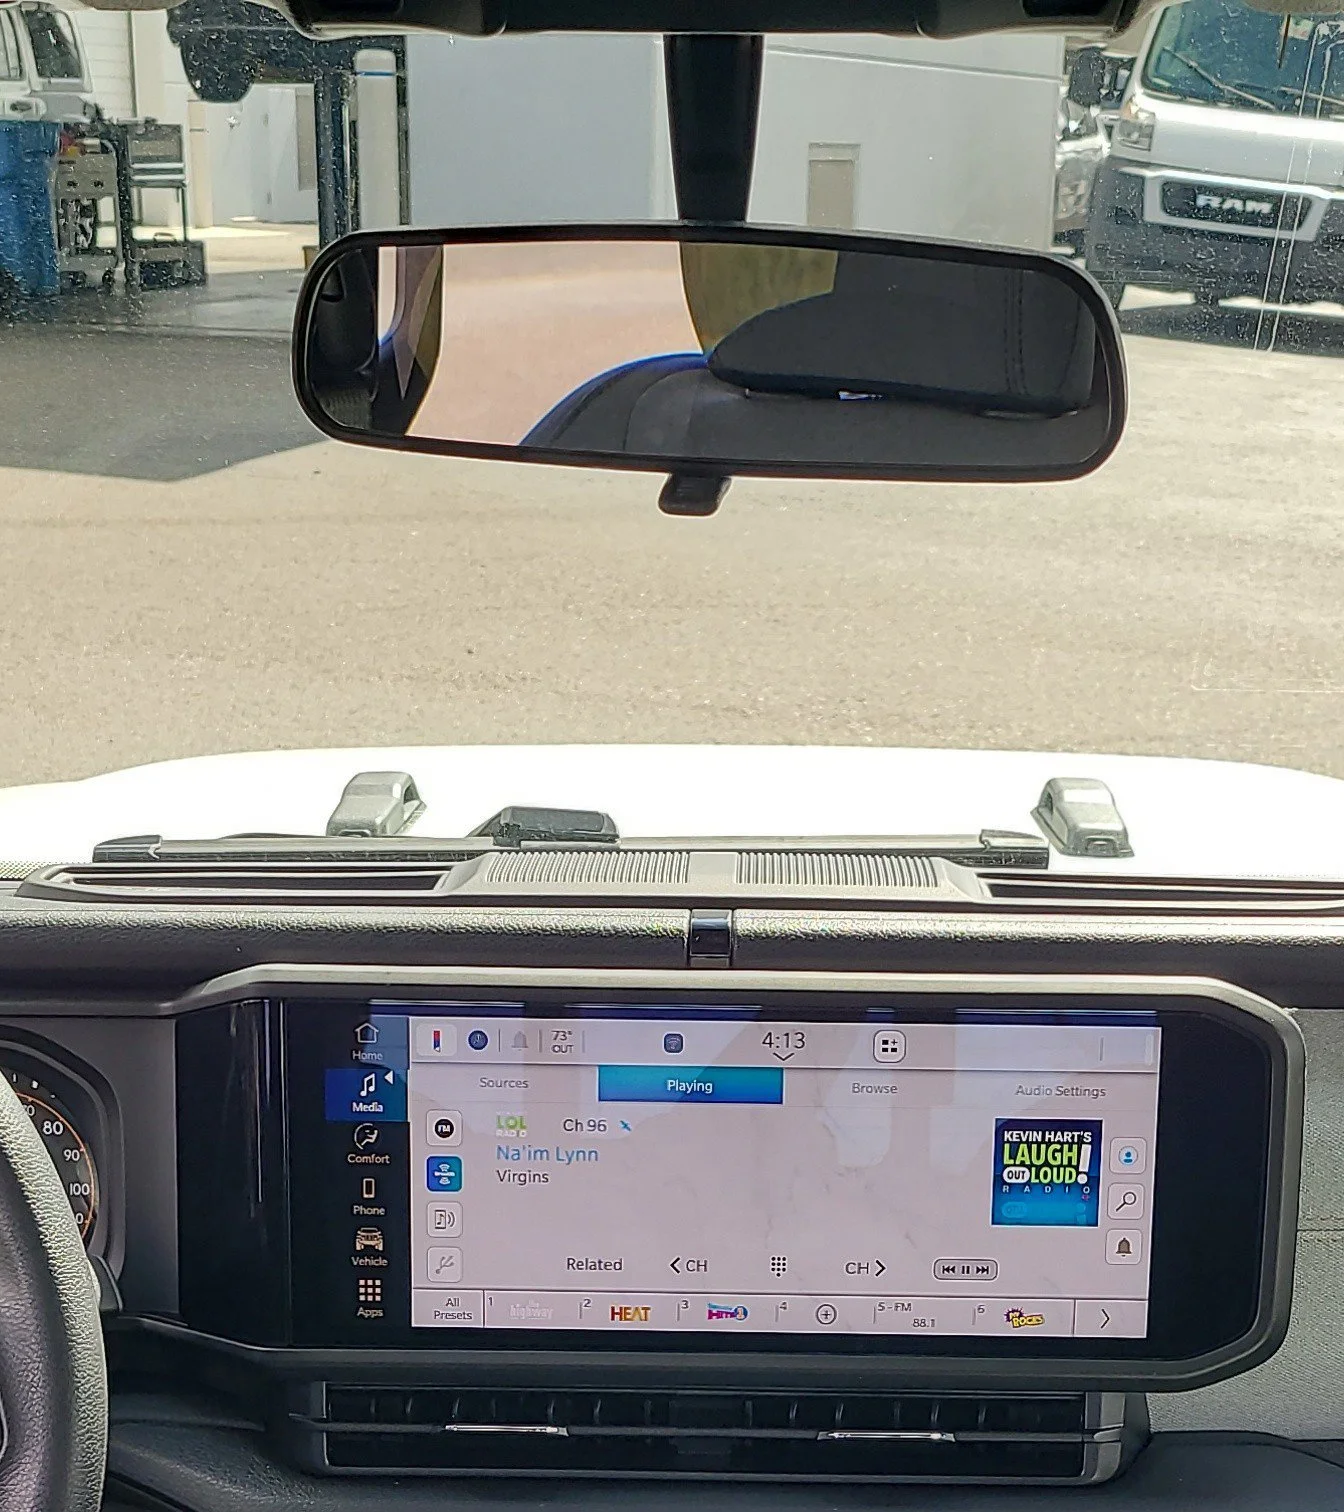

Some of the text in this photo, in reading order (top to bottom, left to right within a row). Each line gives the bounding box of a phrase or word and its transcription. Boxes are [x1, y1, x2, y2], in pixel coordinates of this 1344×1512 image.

[1195, 194, 1272, 214] RAM
[552, 1029, 573, 1041] 73°
[762, 1032, 806, 1050] 4:13
[552, 1043, 574, 1054] OUT
[352, 1050, 384, 1061] Home
[479, 1077, 529, 1089] Sources
[667, 1078, 713, 1093] Playing
[852, 1082, 898, 1094] Browse
[1015, 1084, 1106, 1100] Audio Settings
[352, 1101, 384, 1113] Media
[42, 1120, 64, 1135] 80
[497, 1115, 527, 1129] LOL
[563, 1119, 607, 1132] Ch 96
[1004, 1131, 1092, 1142] KEVIN HART'S
[63, 1149, 81, 1161] 90
[347, 1153, 390, 1164] Comfort
[497, 1145, 598, 1165] Na'im Lynn
[1003, 1144, 1078, 1165] LAUGH
[497, 1170, 549, 1185] Virgins
[1007, 1170, 1026, 1180] OUT
[69, 1182, 90, 1196] 100
[353, 1205, 386, 1216] Phone
[351, 1256, 388, 1267] Vehicle
[567, 1258, 623, 1271] Related
[686, 1260, 707, 1272] CH
[845, 1263, 869, 1275] CH
[446, 1297, 459, 1307] All
[584, 1299, 591, 1308] 2
[682, 1300, 689, 1309] 3
[779, 1302, 787, 1311] 4
[357, 1307, 384, 1319] Apps
[434, 1310, 472, 1321] Presets
[611, 1306, 651, 1322] HEAT
[913, 1319, 936, 1327] 88.1
